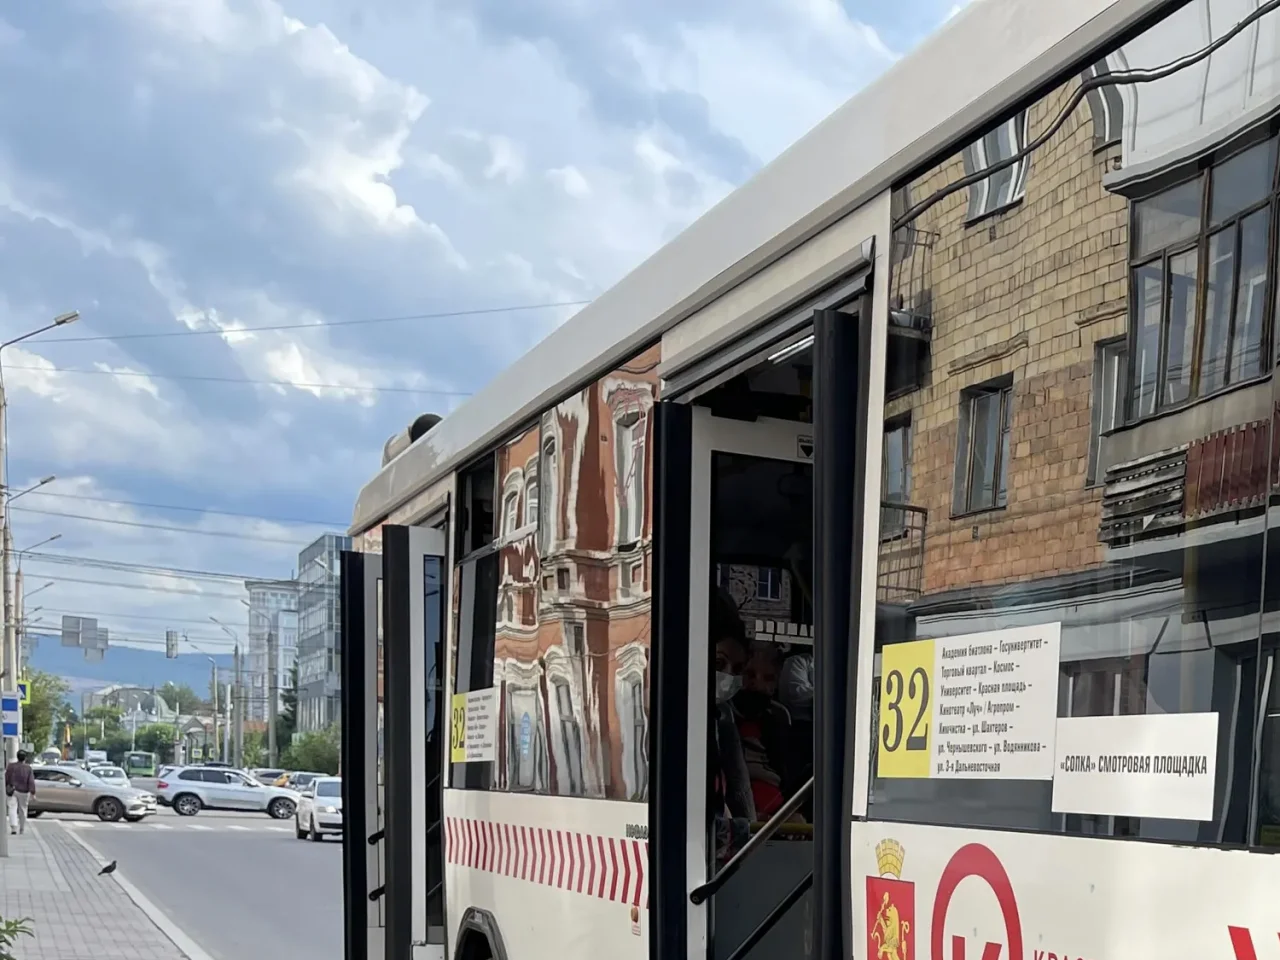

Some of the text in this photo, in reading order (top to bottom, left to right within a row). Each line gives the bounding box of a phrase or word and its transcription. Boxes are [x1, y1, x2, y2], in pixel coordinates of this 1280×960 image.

[941, 646, 968, 660] Академия
[968, 644, 993, 657] биатлона
[941, 664, 965, 680] Торговый
[966, 665, 987, 679] квартал
[993, 660, 1015, 674] Космос
[978, 681, 1000, 697] Красная
[1001, 680, 1026, 693] площадь
[882, 666, 930, 752] 32
[939, 703, 965, 718] Кинотеатр
[453, 706, 465, 749] 32
[981, 720, 1008, 736] Шахтеров
[1060, 755, 1208, 778] «СОПКА» СМОТРОВАЯ ПЛОЩАДКА
